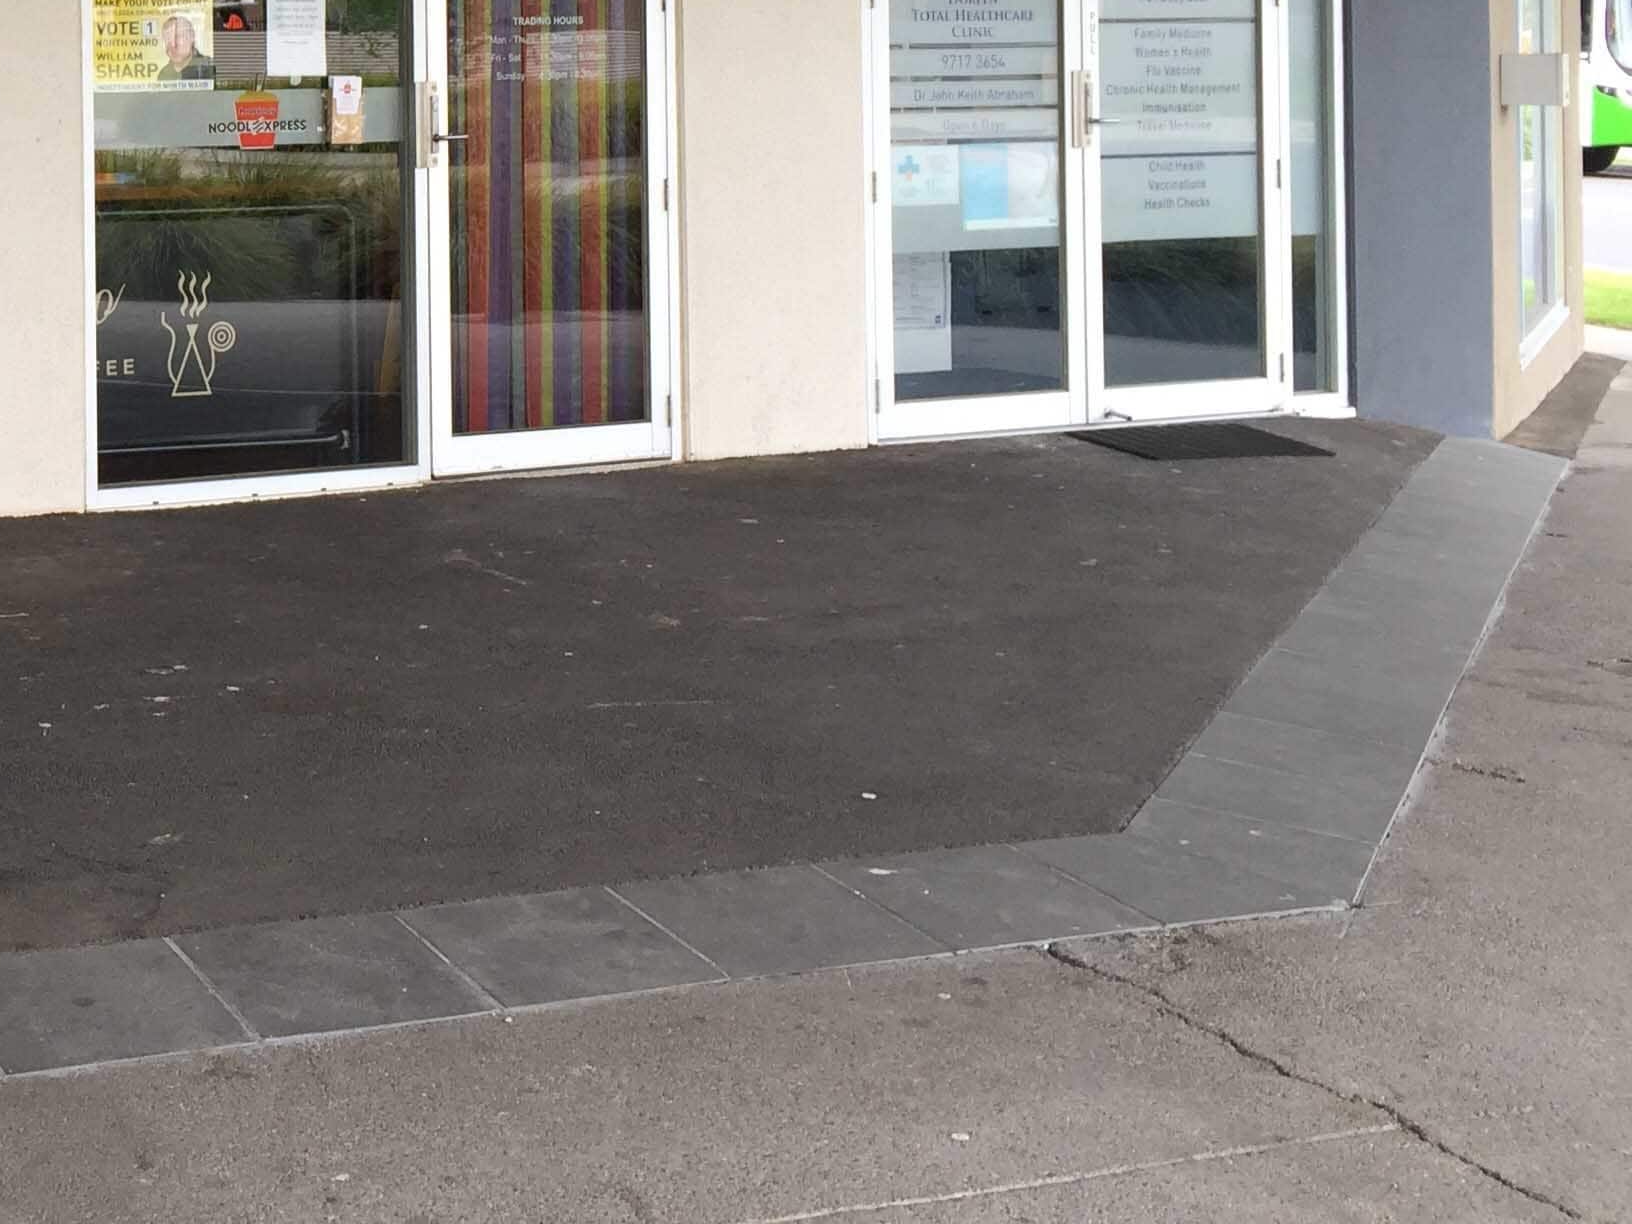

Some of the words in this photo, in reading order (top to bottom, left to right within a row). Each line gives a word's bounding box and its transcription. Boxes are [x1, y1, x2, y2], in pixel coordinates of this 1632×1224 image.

[95, 0, 121, 7] MAKE
[124, 0, 149, 7] YOUR
[513, 17, 551, 26] TRADING
[553, 16, 584, 25] HOURS
[96, 21, 139, 35] VOTE
[146, 22, 153, 34] 1
[129, 38, 158, 47] WARD
[96, 52, 143, 61] WILLIAM
[942, 54, 972, 70] 9717
[96, 63, 159, 78] SHARP
